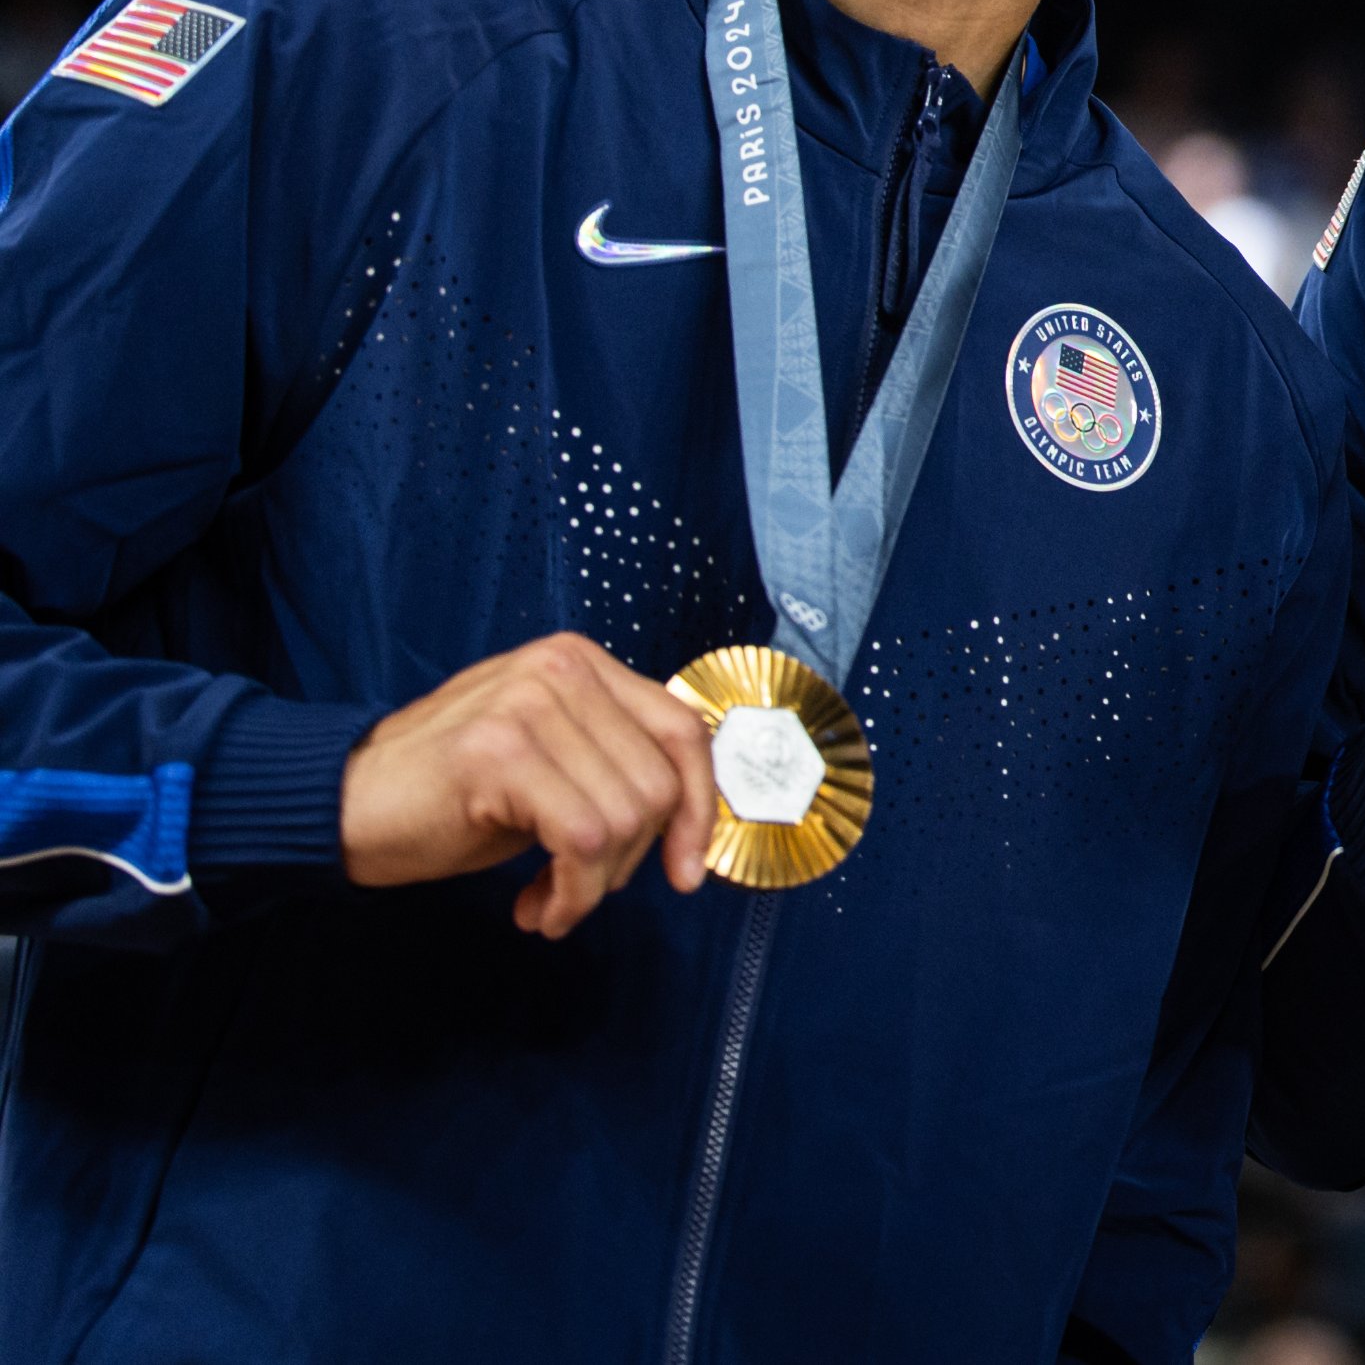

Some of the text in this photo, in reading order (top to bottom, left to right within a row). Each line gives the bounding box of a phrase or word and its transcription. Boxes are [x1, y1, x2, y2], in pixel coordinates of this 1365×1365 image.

[723, 0, 758, 95] 2024
[1035, 315, 1143, 382] UNITED STATES
[1024, 416, 1133, 480] OLYMPIC TEAM
